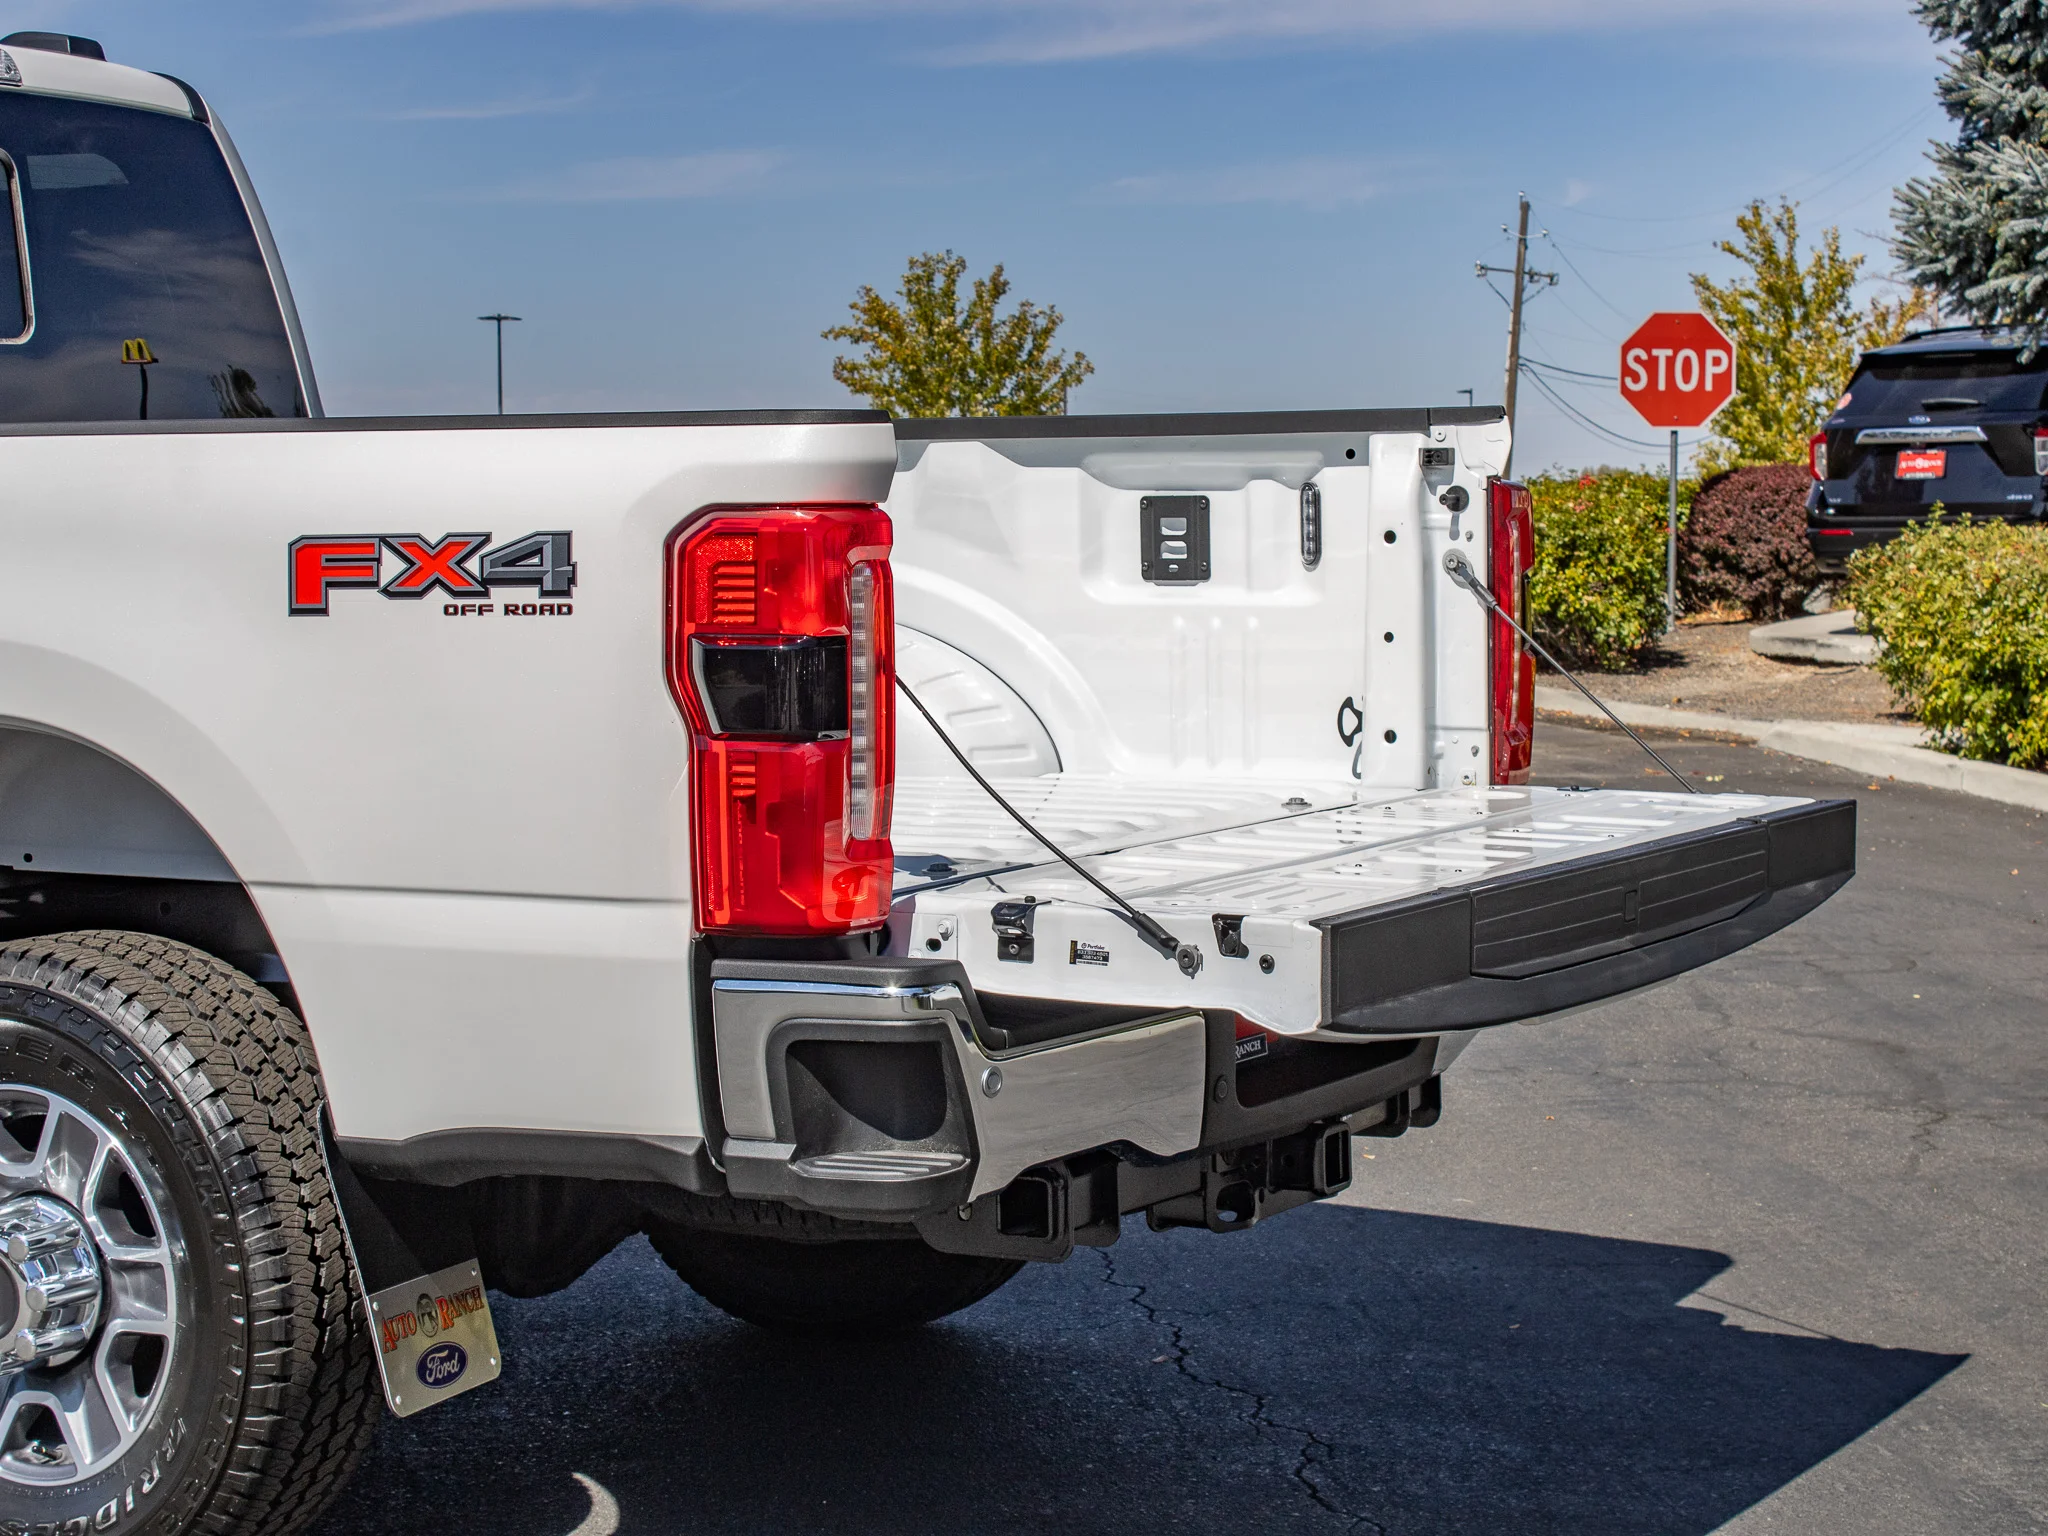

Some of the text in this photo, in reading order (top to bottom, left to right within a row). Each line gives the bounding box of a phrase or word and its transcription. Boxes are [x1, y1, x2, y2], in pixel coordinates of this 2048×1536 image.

[1624, 347, 1729, 392] STOP
[288, 530, 577, 617] FX4
[443, 603, 574, 617] OFF ROAD
[381, 1285, 485, 1353] AUTO RANCH
[426, 1349, 460, 1384] Ford
